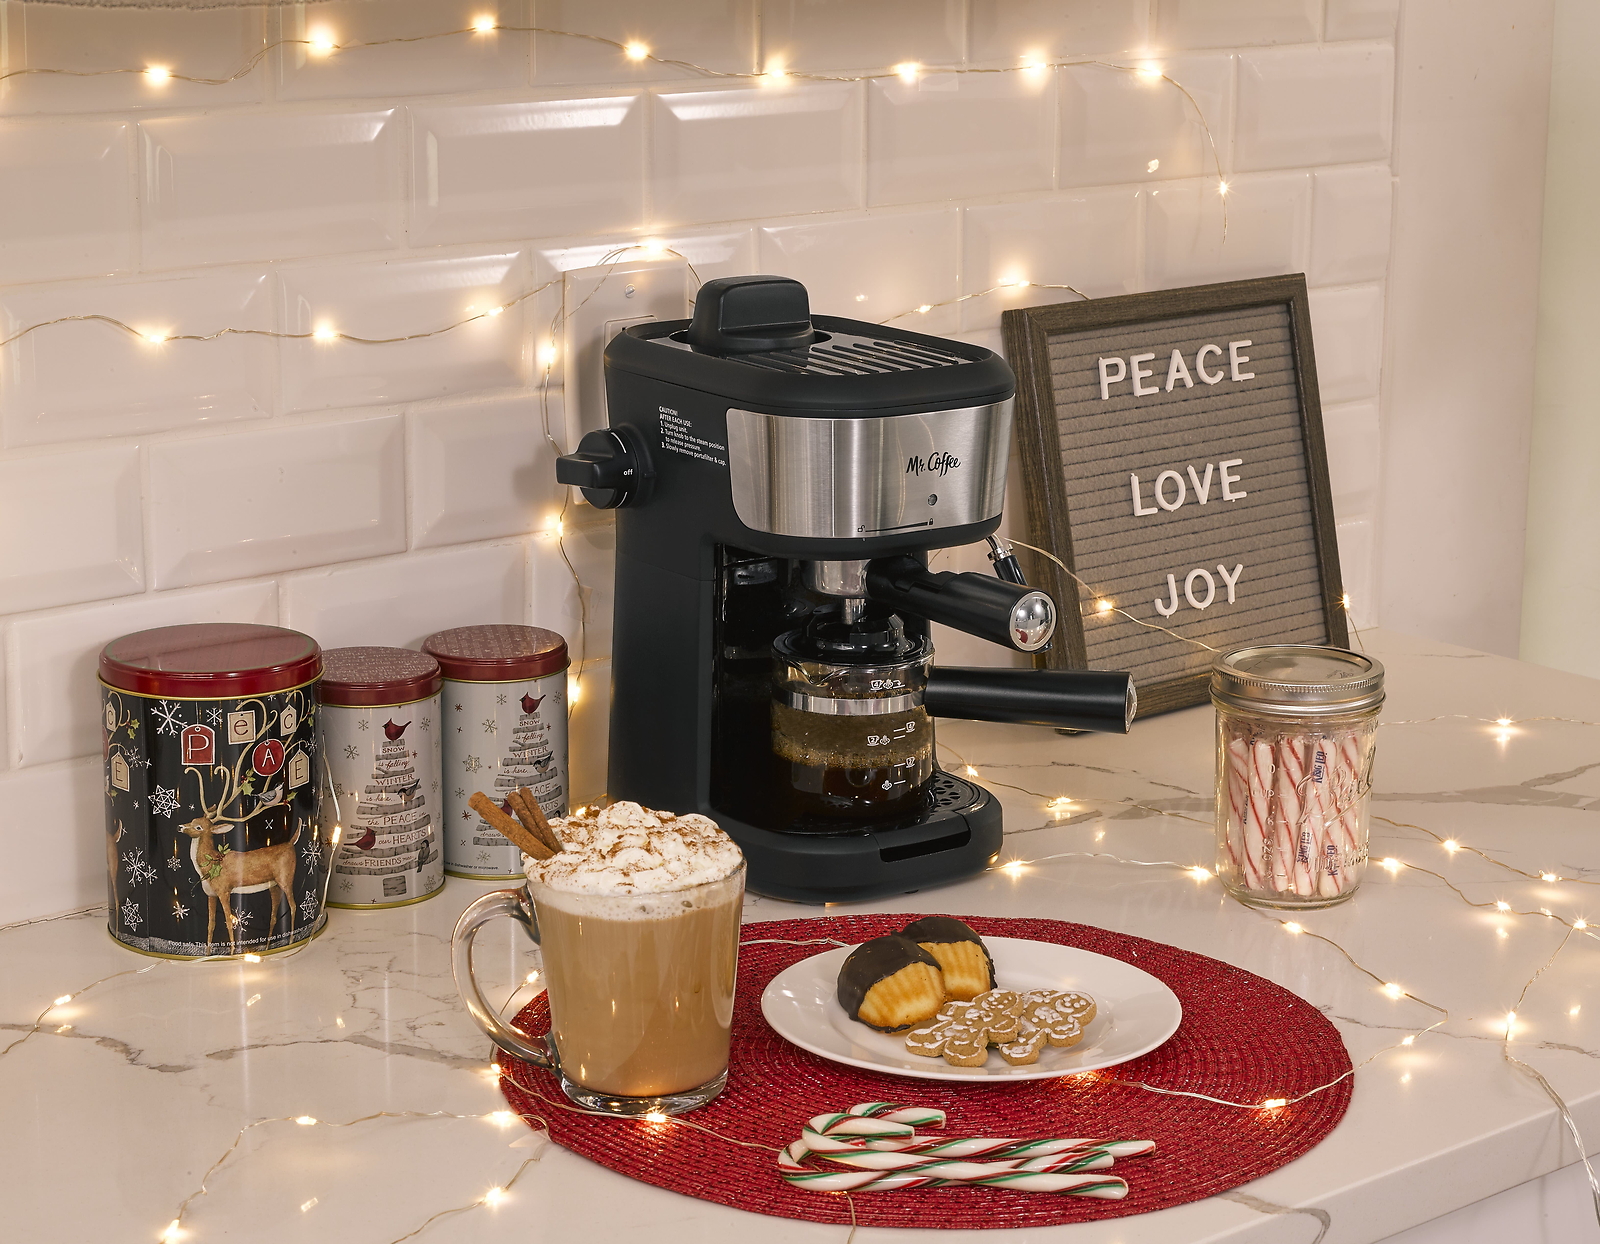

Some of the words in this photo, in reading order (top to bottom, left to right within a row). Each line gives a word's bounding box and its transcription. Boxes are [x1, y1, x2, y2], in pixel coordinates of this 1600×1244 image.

[1098, 339, 1255, 400] PEACE
[623, 468, 633, 476] off
[906, 455, 926, 476] Mr.
[927, 451, 961, 478] Coffee
[1130, 457, 1247, 517] LOVE
[1154, 563, 1244, 618] JOY
[519, 719, 540, 727] SNOW
[187, 734, 210, 759] P
[262, 748, 275, 767] A
[295, 759, 303, 780] E
[382, 746, 405, 754] SNOW
[512, 745, 549, 758] WINTER
[375, 773, 415, 786] WINTER
[383, 811, 417, 826] PEACE
[392, 828, 427, 845] HEARTS
[364, 857, 402, 867] FRIENDS
